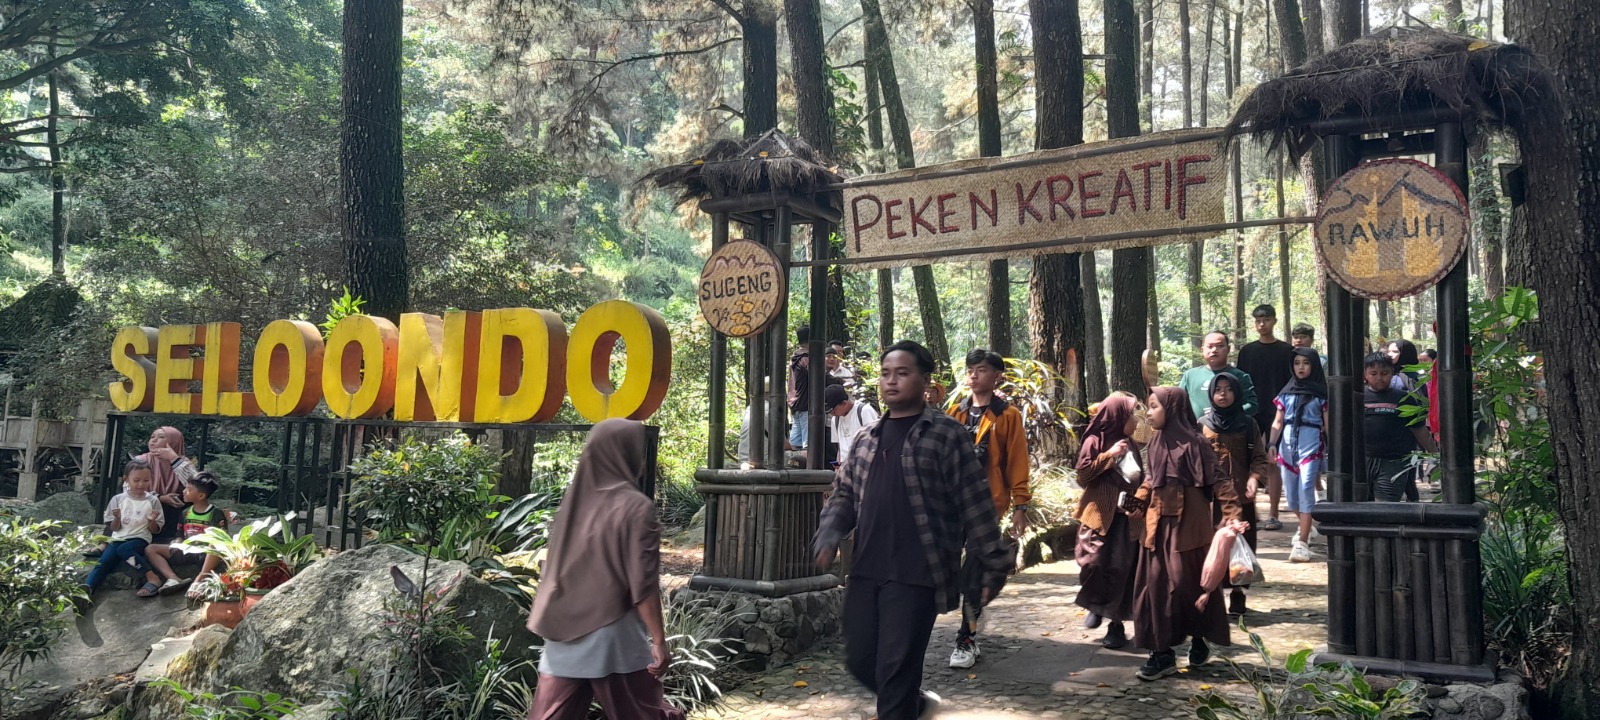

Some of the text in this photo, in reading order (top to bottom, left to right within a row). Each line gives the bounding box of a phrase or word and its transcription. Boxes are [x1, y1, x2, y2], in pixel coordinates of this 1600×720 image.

[851, 154, 1211, 252] PEKEN KREATIF
[1329, 213, 1445, 246] RAWUH
[701, 271, 772, 301] SUGENG
[109, 299, 671, 422] SELOONDO
